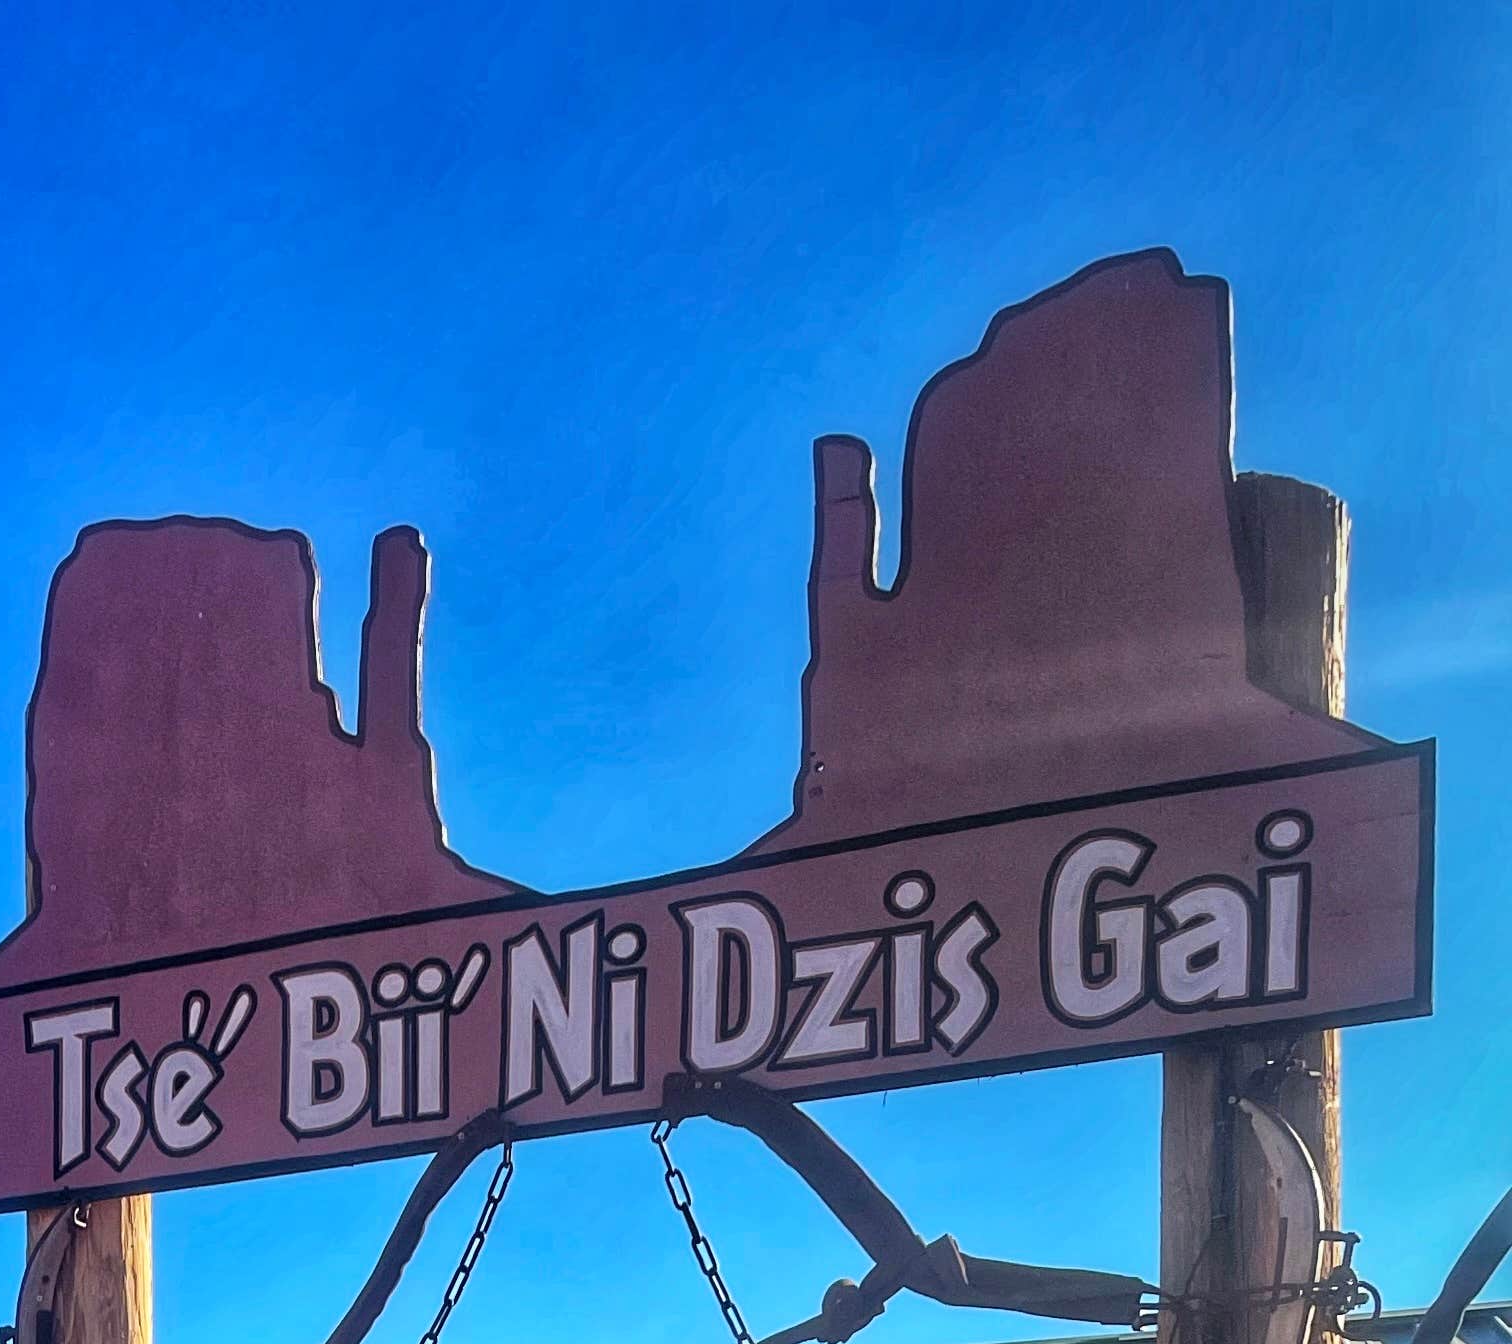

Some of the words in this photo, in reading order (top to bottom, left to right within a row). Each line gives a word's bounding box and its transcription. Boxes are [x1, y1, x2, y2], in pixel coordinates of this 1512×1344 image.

[501, 911, 645, 1106] Ni
[672, 872, 999, 1070] Dzis
[1042, 811, 1311, 1027] Gai
